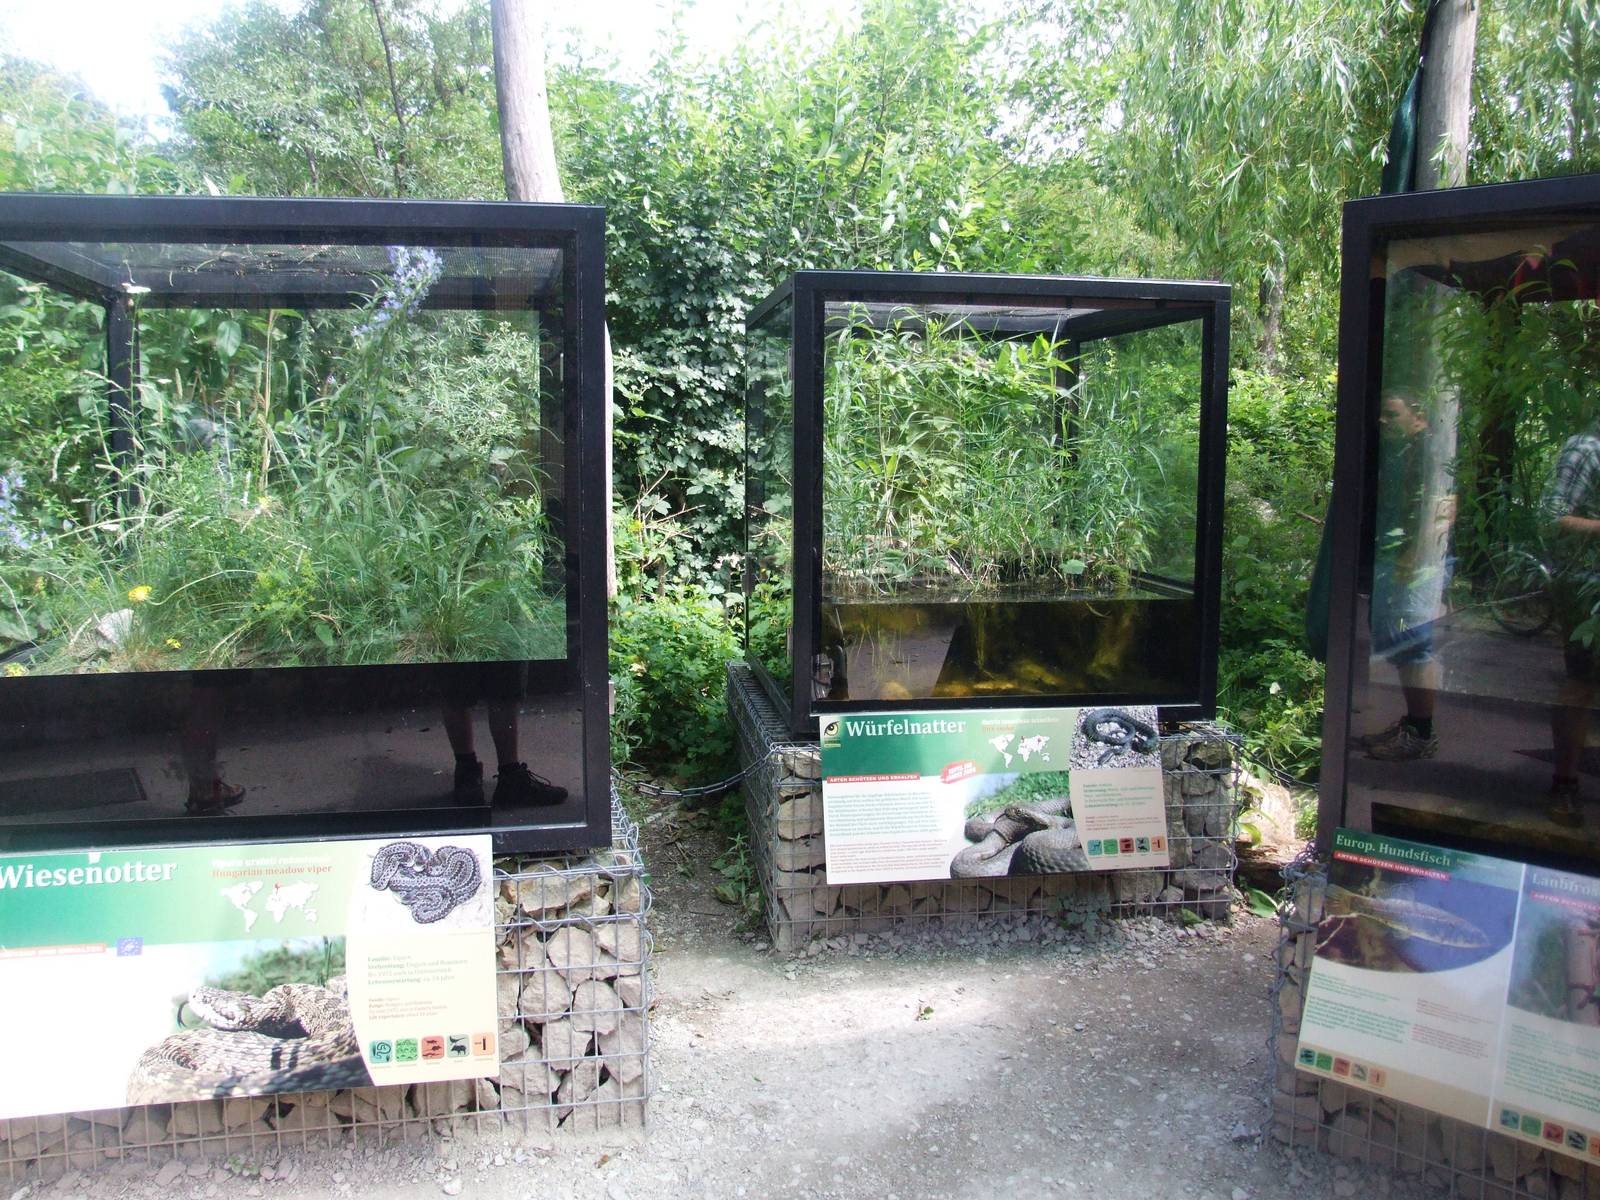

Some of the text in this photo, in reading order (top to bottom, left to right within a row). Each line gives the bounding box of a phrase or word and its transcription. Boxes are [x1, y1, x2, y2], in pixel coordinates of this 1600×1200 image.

[846, 719, 966, 737] Würfelnatter
[1336, 834, 1376, 853] Europ.
[1379, 842, 1451, 867] Hundsfisch
[0, 861, 177, 889] Wiesenotter
[265, 865, 305, 876] meadow
[307, 864, 333, 875] viper
[1394, 863, 1410, 872] UND
